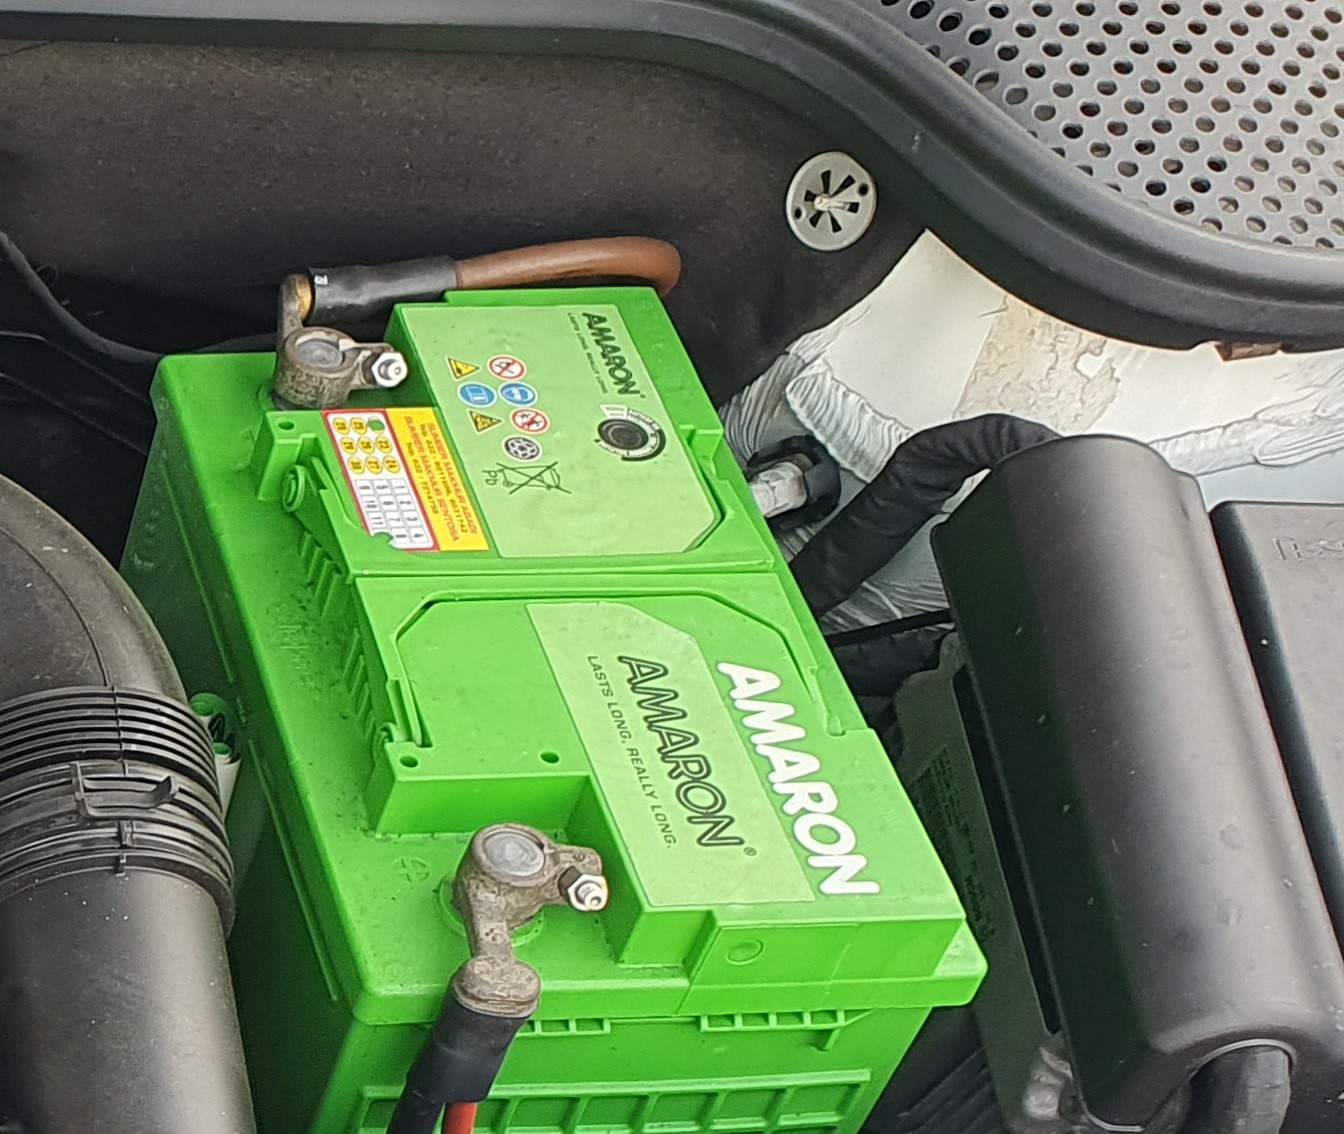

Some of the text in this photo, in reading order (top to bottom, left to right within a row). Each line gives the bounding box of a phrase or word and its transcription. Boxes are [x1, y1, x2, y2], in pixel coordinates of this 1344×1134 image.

[582, 312, 640, 395] AMARON
[481, 470, 498, 486] Pb
[587, 655, 612, 696] LASTS
[626, 747, 659, 799] REALLY
[617, 655, 746, 848] AMARON
[717, 662, 881, 895] AMARON
